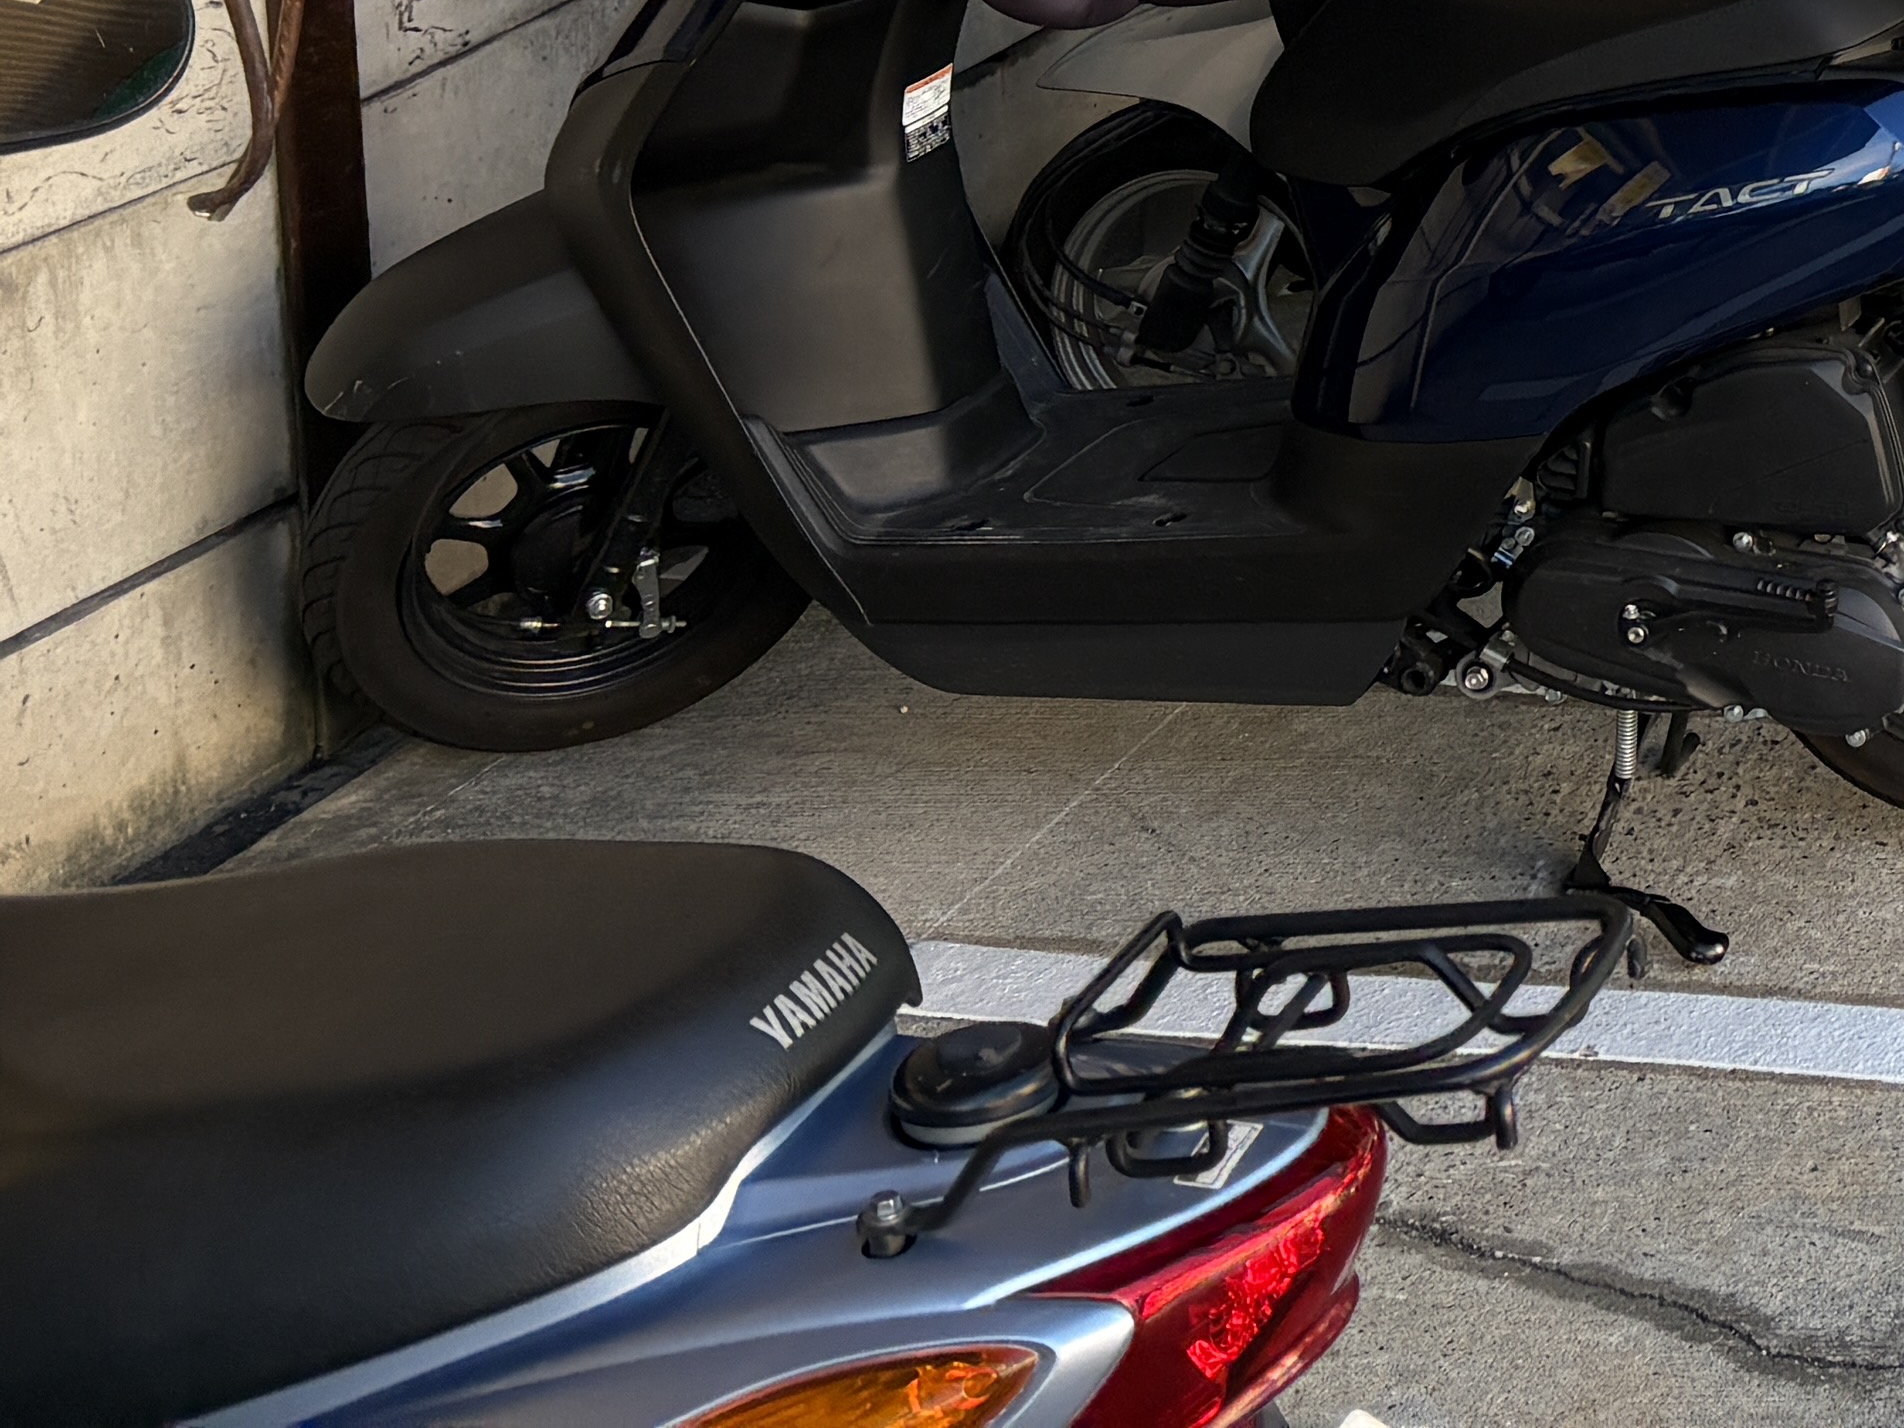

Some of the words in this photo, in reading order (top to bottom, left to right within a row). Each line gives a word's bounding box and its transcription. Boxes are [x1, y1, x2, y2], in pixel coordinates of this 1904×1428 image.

[1645, 169, 1835, 219] TACT
[1752, 649, 1852, 683] HONDA
[749, 931, 878, 1050] YAMAHA
